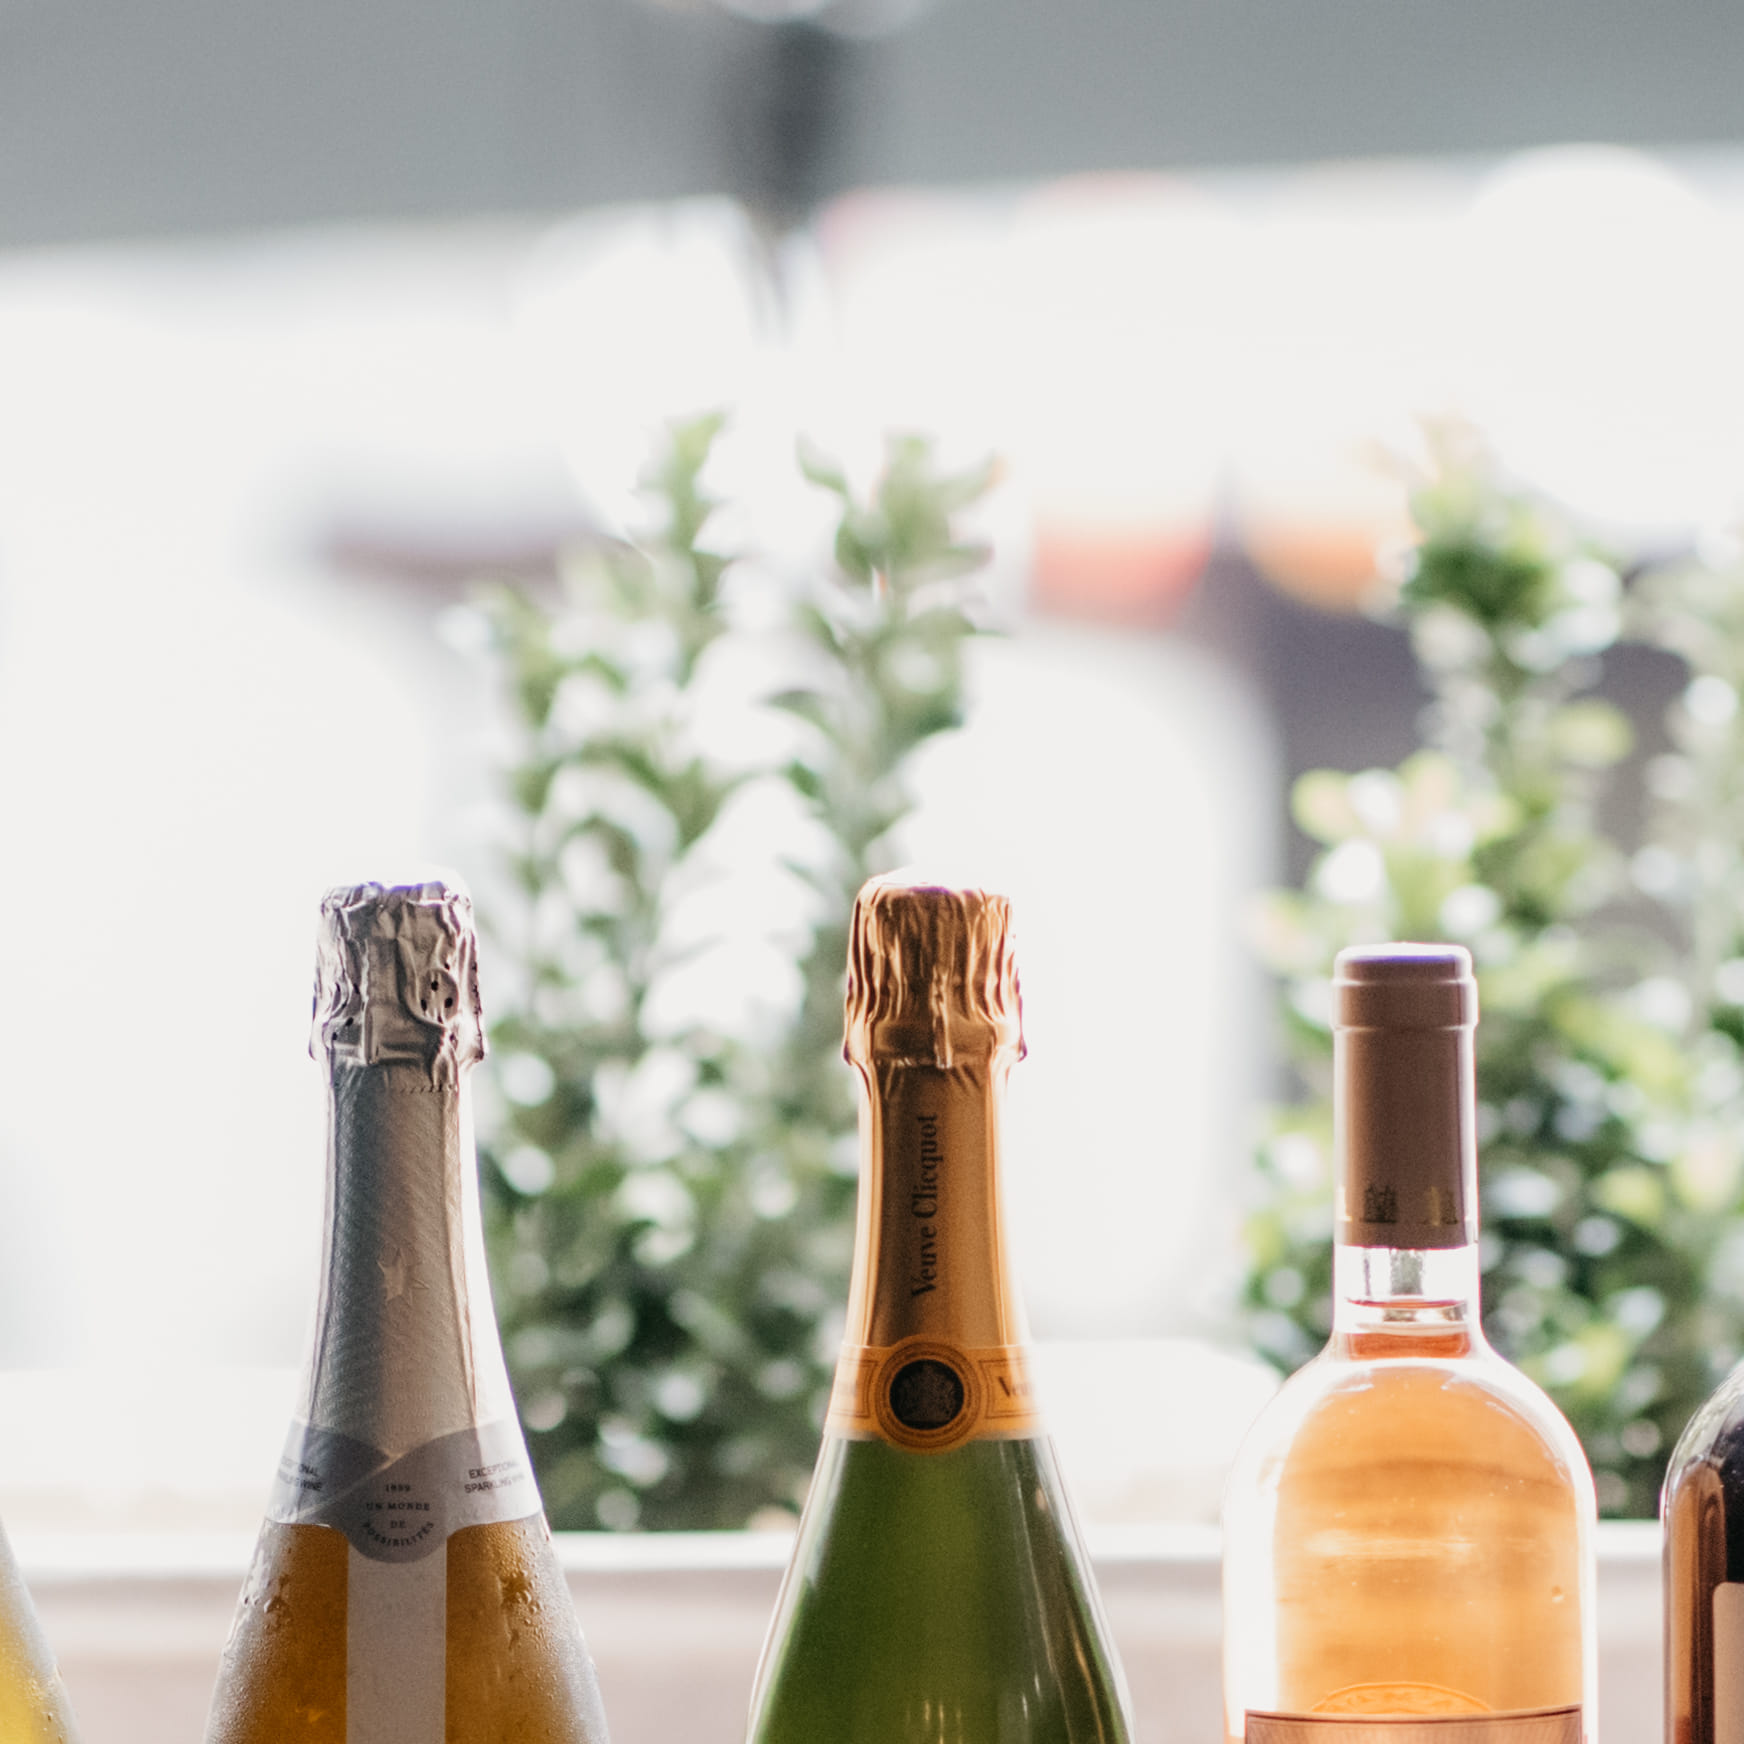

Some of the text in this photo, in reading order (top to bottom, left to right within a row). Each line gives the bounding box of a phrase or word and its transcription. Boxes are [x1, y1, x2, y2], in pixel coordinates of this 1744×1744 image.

[912, 1114, 944, 1298] Veuve Clicquot
[390, 1520, 405, 1529] DE
